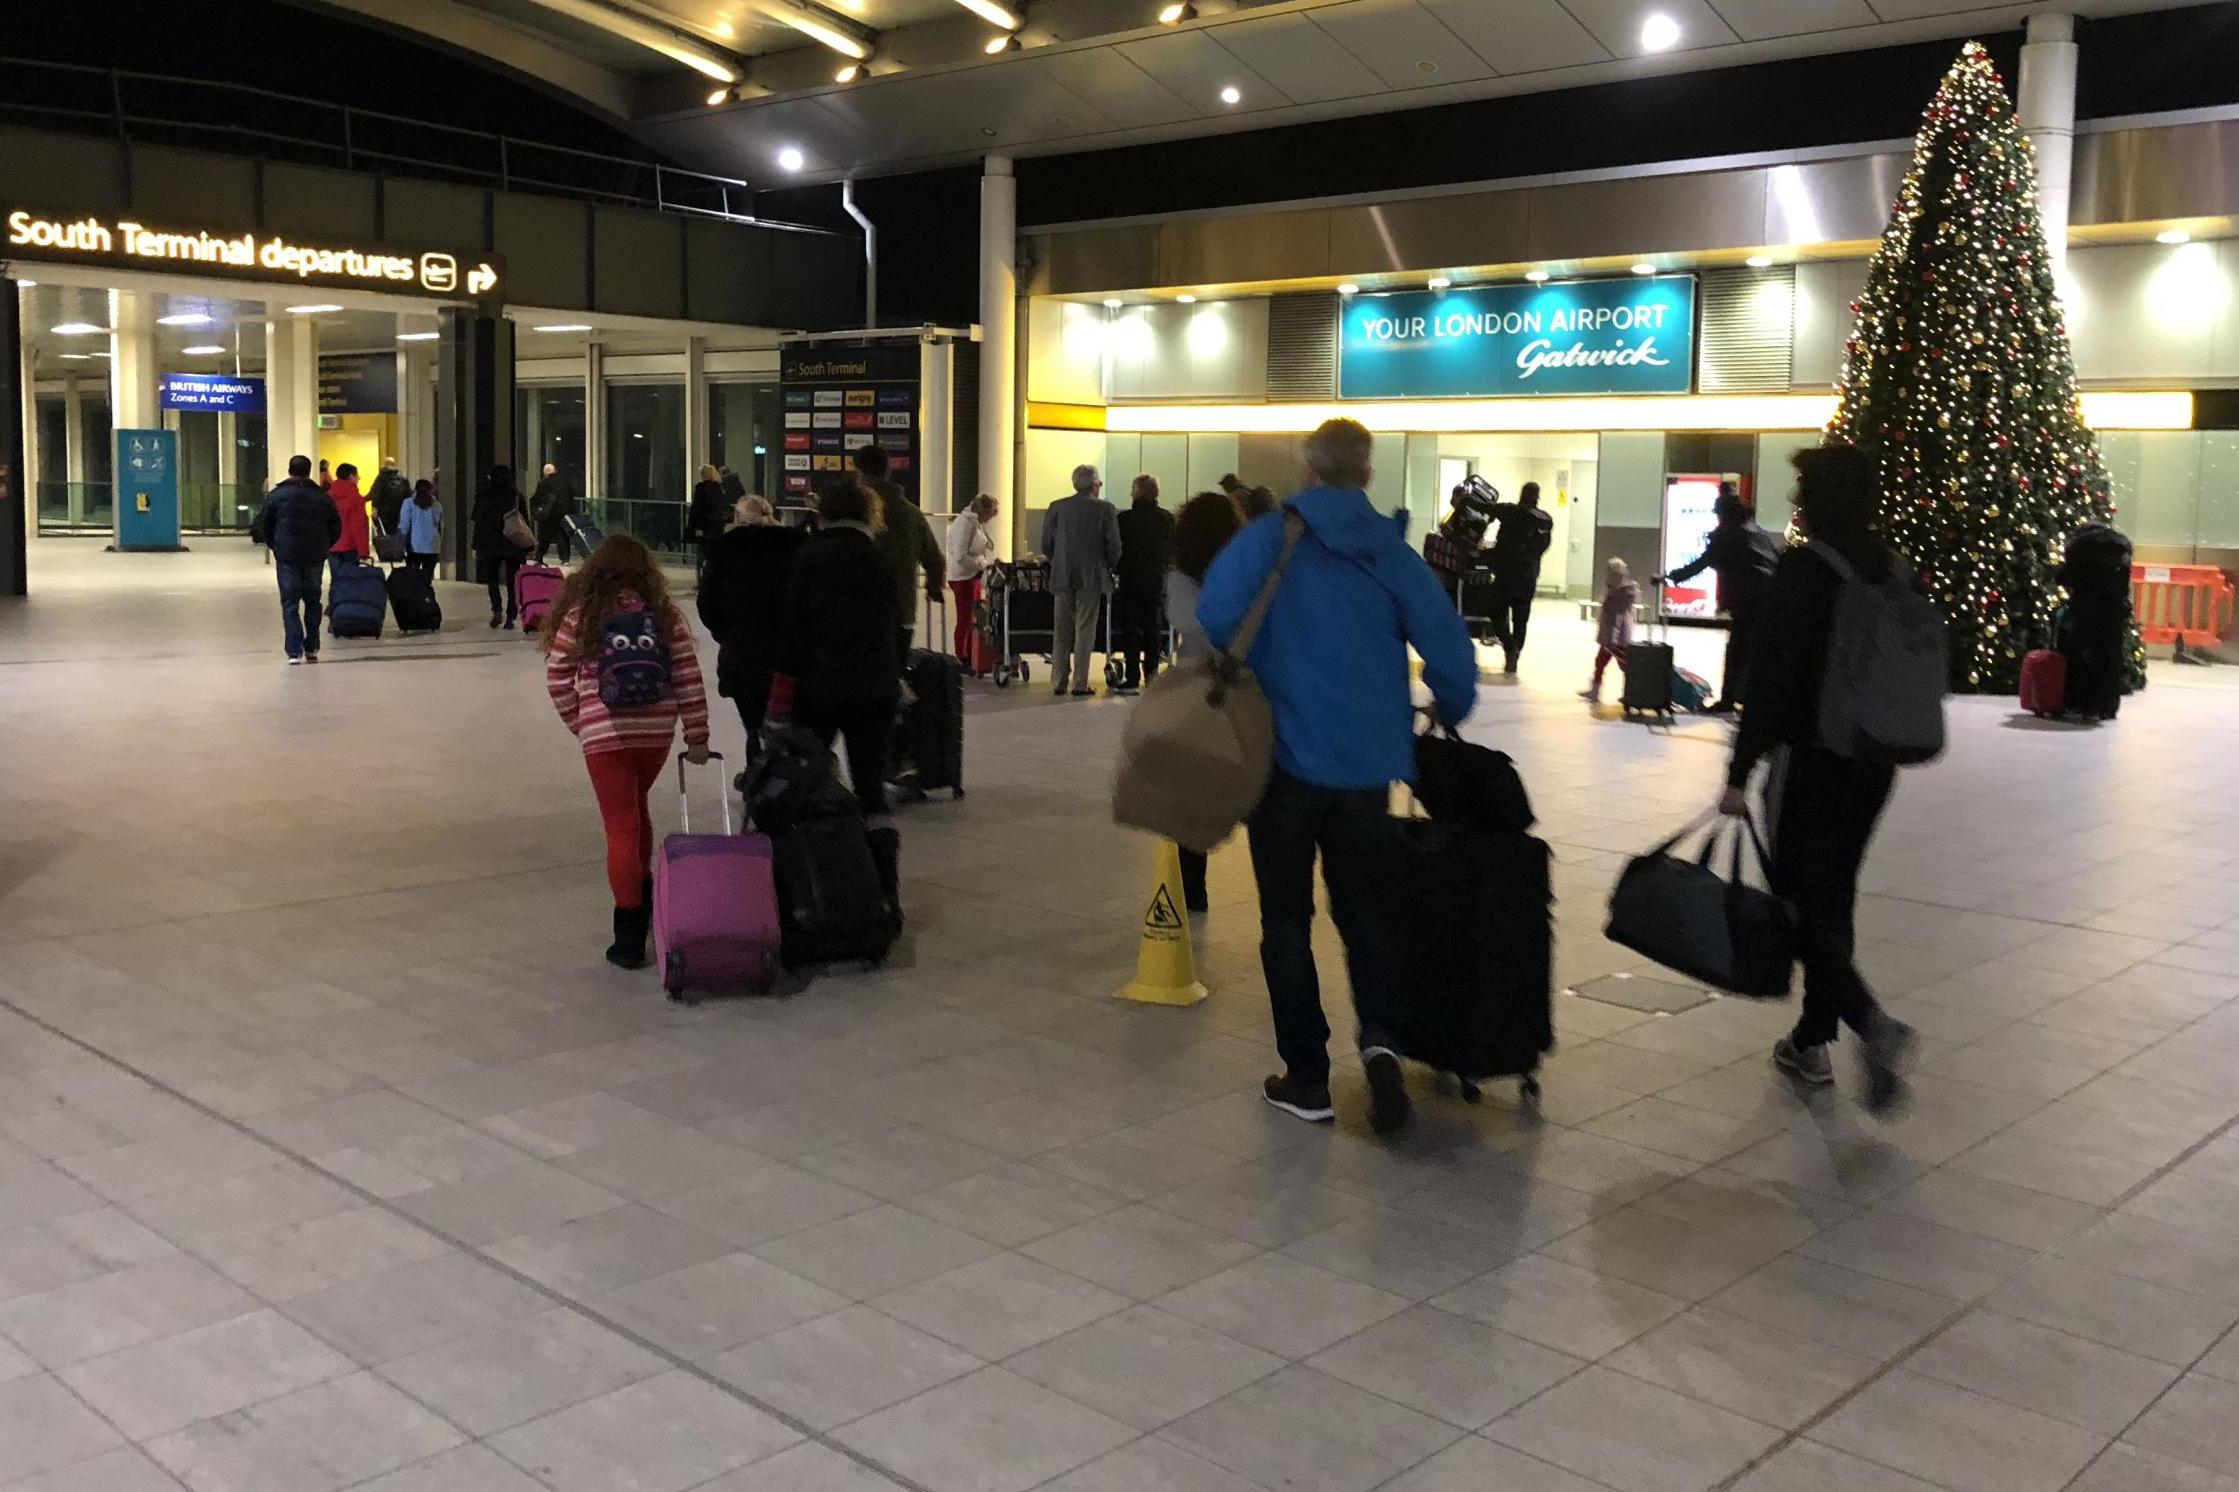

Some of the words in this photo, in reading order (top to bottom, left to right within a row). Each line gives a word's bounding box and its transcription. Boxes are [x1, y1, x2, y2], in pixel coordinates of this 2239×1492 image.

[9, 211, 111, 251] South
[117, 222, 254, 265] Terminal
[260, 236, 415, 280] departures
[1362, 316, 1426, 340] YOUR
[1434, 311, 1542, 338] LONDON
[1551, 303, 1669, 334] AIRPORT
[1516, 336, 1670, 379] Gatwick
[799, 361, 825, 376] South
[827, 361, 866, 375] Terminal
[170, 382, 210, 393] BRITISH
[211, 383, 253, 394] AIRWAYS
[170, 393, 198, 403] Zones
[200, 393, 207, 402] A
[209, 395, 225, 404] and
[226, 395, 234, 404] C
[885, 415, 908, 425] LEVEL
